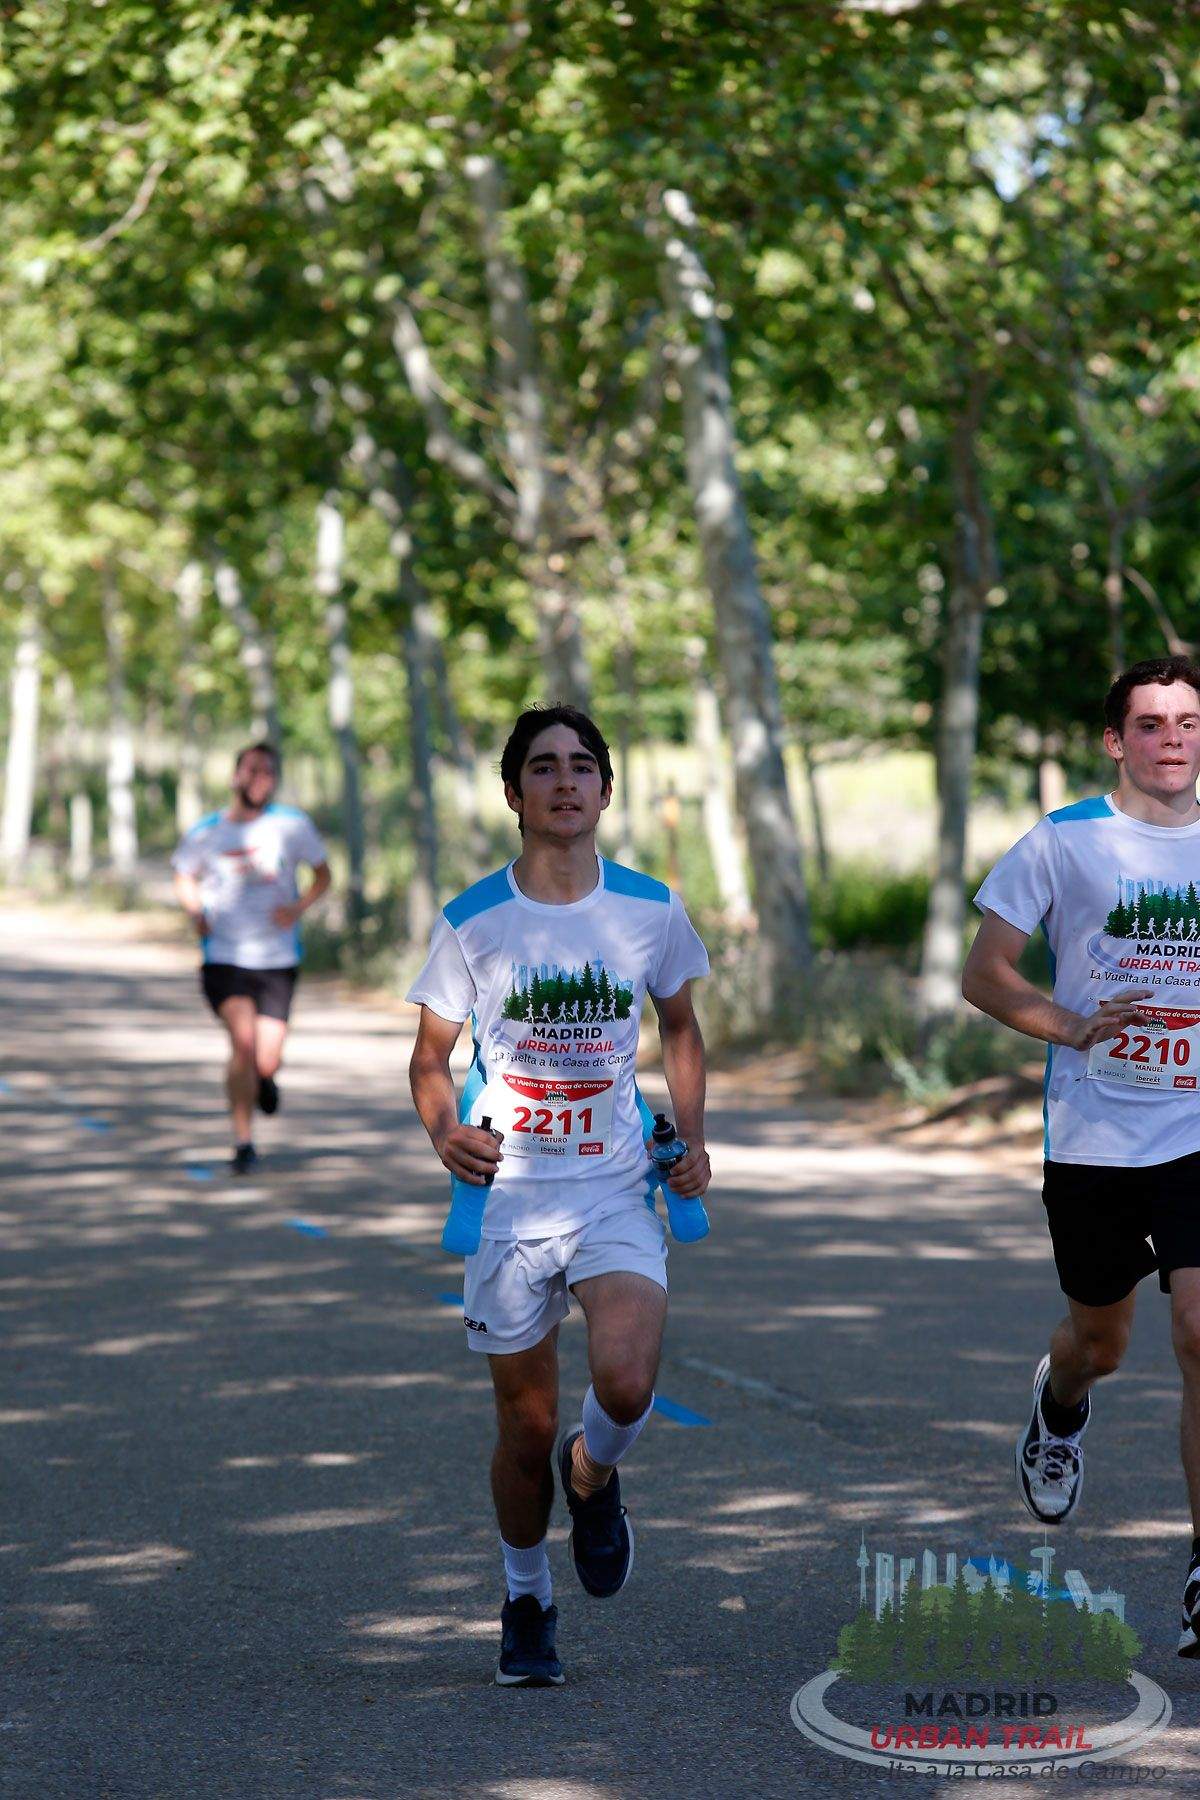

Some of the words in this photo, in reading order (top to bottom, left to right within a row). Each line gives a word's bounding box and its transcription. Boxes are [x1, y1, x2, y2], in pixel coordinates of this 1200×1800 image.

[1118, 958, 1174, 970] URBAN
[1090, 970, 1100, 980] La
[1104, 971, 1139, 984] Vuelta
[1152, 975, 1162, 984] la
[1165, 976, 1190, 986] Casa
[532, 1026, 602, 1040] MADRID
[516, 1040, 572, 1054] URBAN
[575, 1040, 615, 1053] TRAIL
[1108, 1032, 1190, 1066] 2210
[549, 1058, 559, 1068] la
[562, 1057, 590, 1068] Casa
[592, 1056, 606, 1067] de
[1135, 1064, 1164, 1072] MANUEL
[516, 1078, 538, 1088] Vuelta
[512, 1106, 592, 1136] 2211
